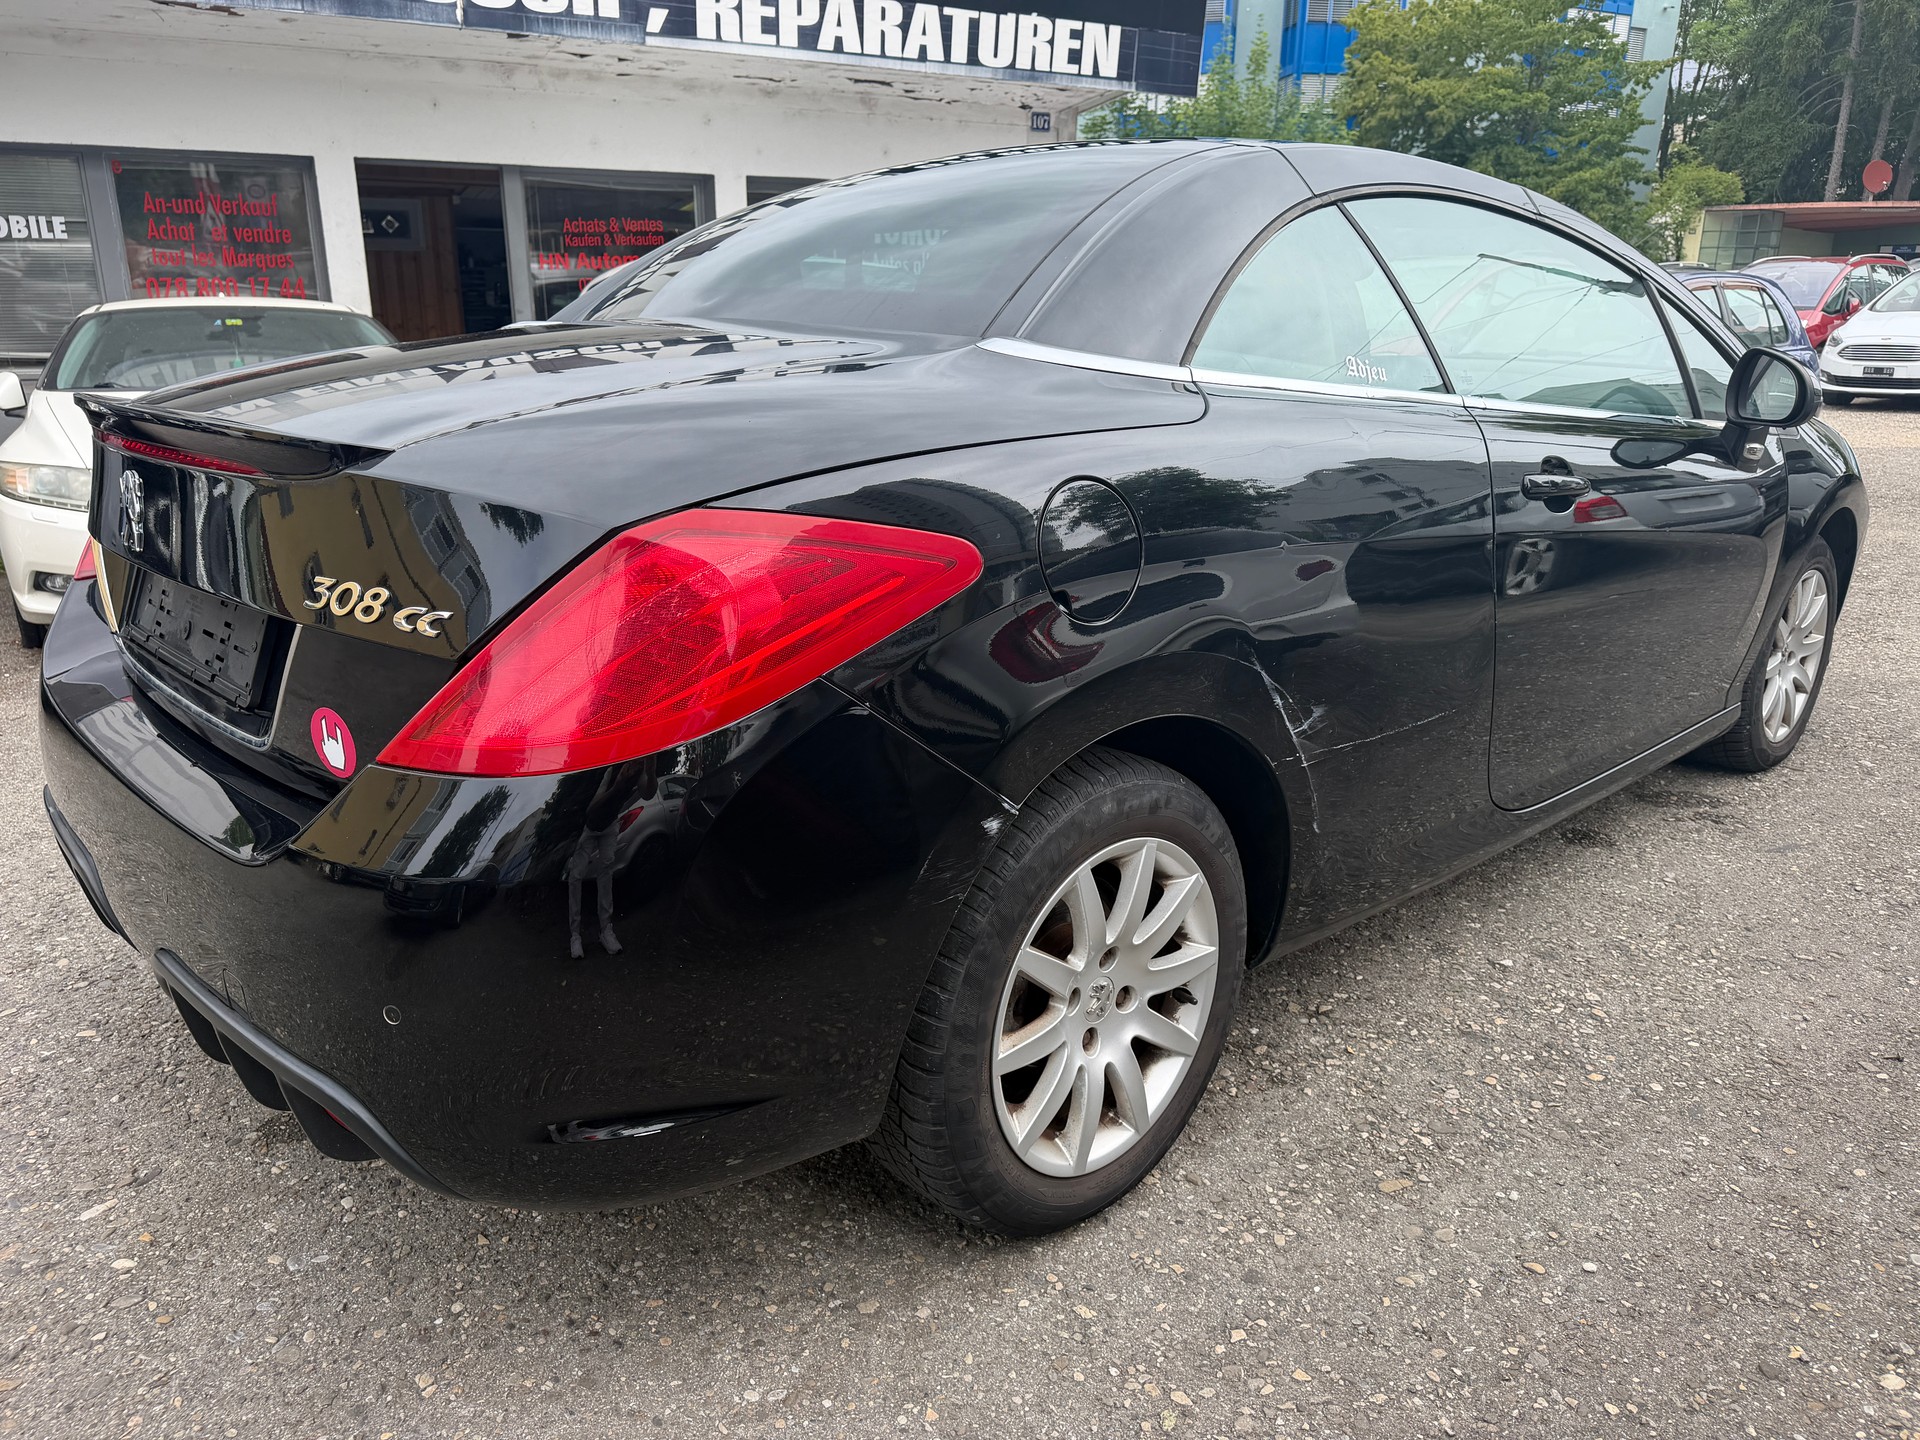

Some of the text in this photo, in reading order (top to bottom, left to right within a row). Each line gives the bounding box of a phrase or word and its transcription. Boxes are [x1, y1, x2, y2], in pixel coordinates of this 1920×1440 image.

[696, 0, 1122, 79] REPARATUREN
[1033, 115, 1049, 129] 107
[143, 191, 277, 217] An-und Verkauf
[147, 217, 292, 243] Achat et vendre
[563, 217, 664, 233] Achats & Ventes
[564, 233, 665, 247] Kaufen & Verkaufen
[191, 243, 217, 267] les
[221, 246, 295, 273] Marques
[538, 252, 571, 270] HN
[145, 276, 189, 298] 078
[247, 276, 271, 298] 17
[279, 276, 307, 299] 44
[303, 575, 391, 624] 308
